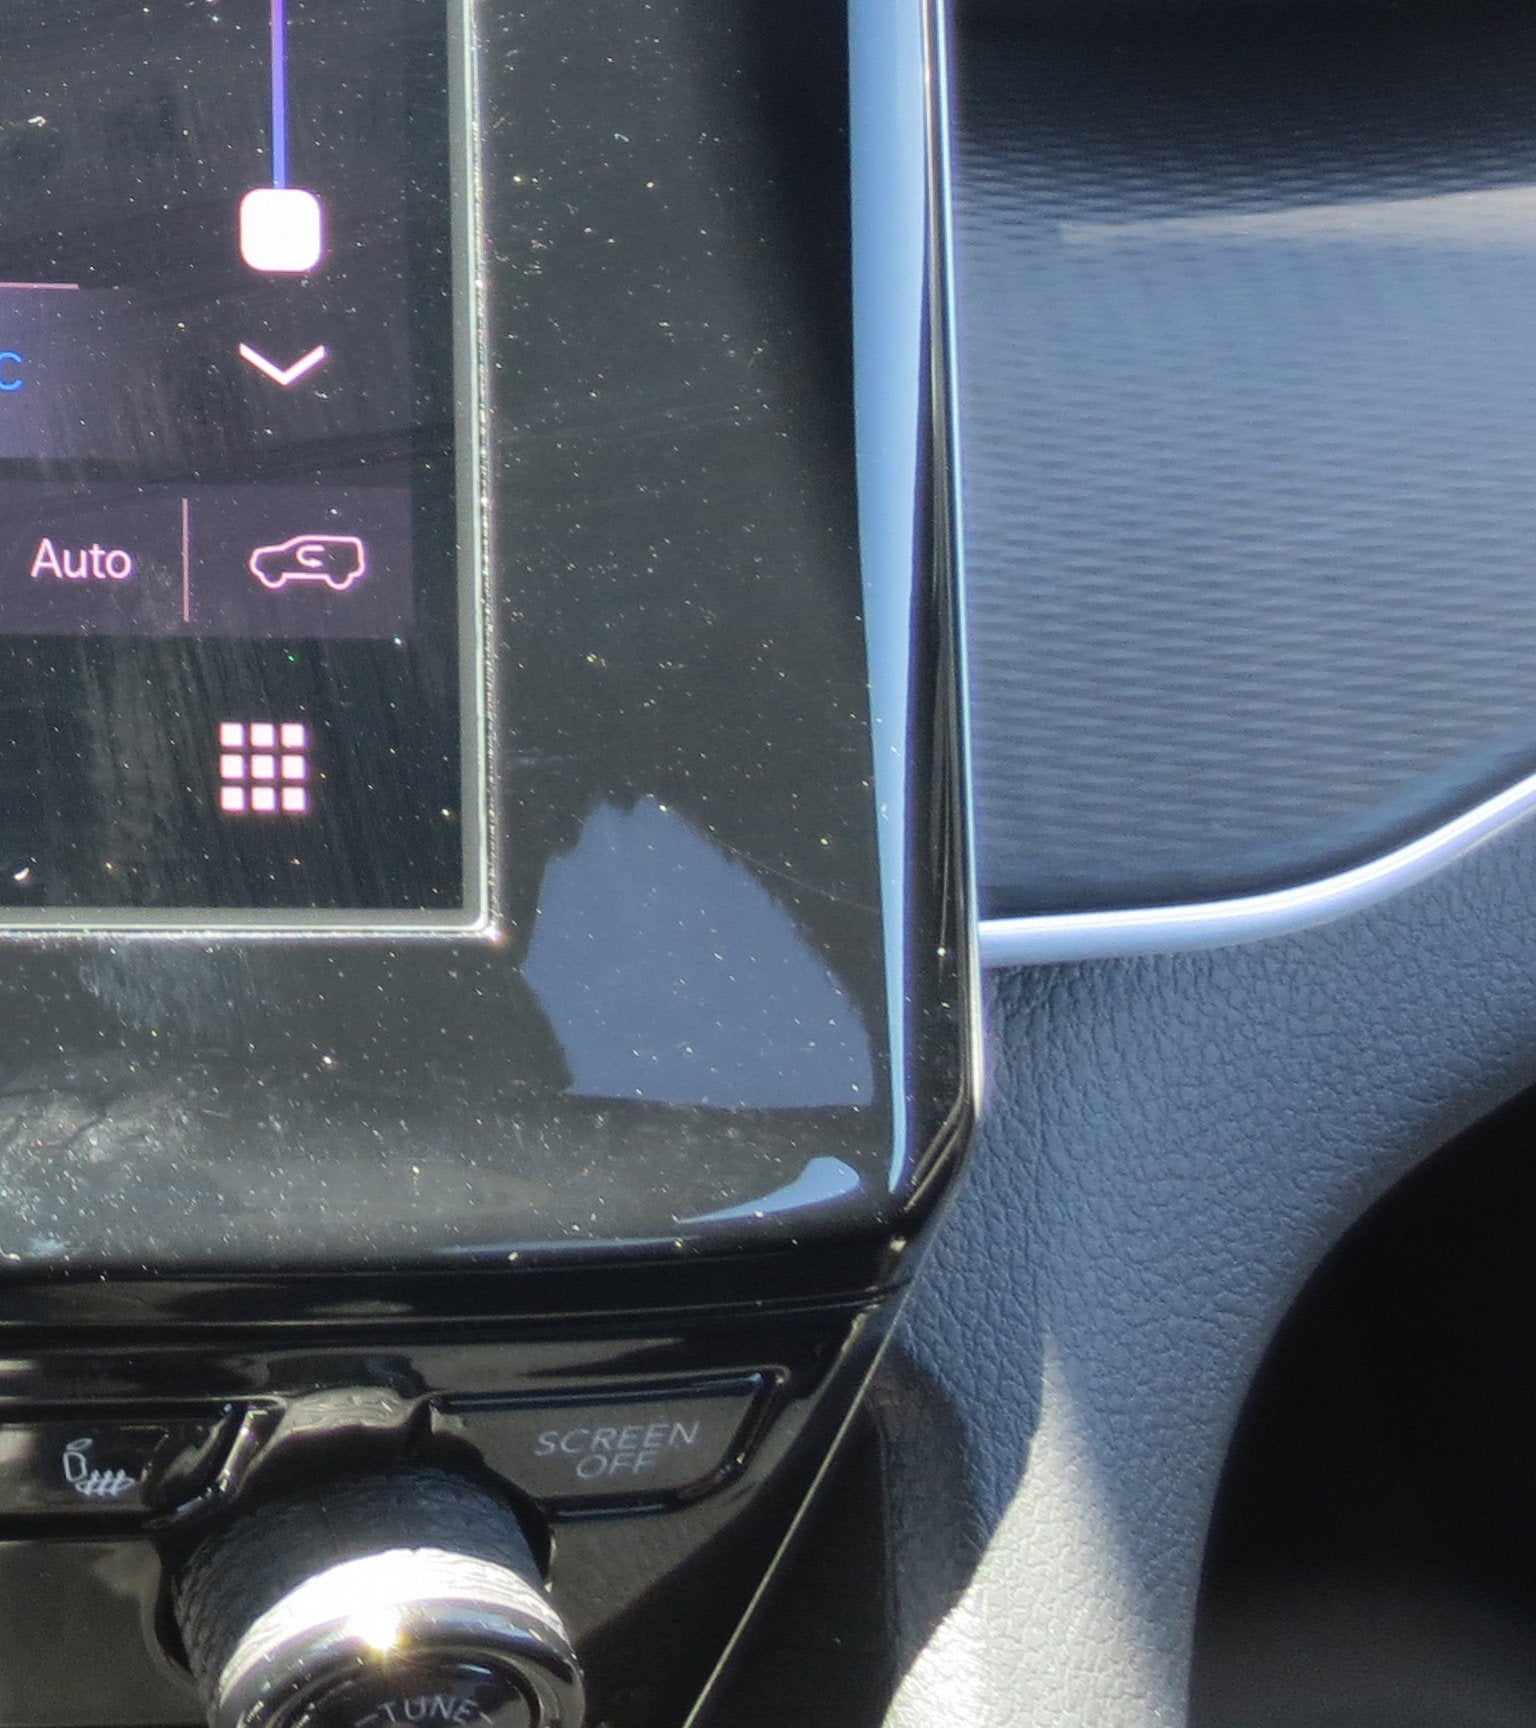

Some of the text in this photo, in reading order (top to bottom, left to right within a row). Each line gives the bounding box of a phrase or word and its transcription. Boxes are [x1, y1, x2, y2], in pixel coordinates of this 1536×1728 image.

[30, 537, 133, 580] Auto
[534, 1422, 700, 1456] SCREEN
[577, 1450, 660, 1478] OFF
[377, 1694, 478, 1723] TUNE
